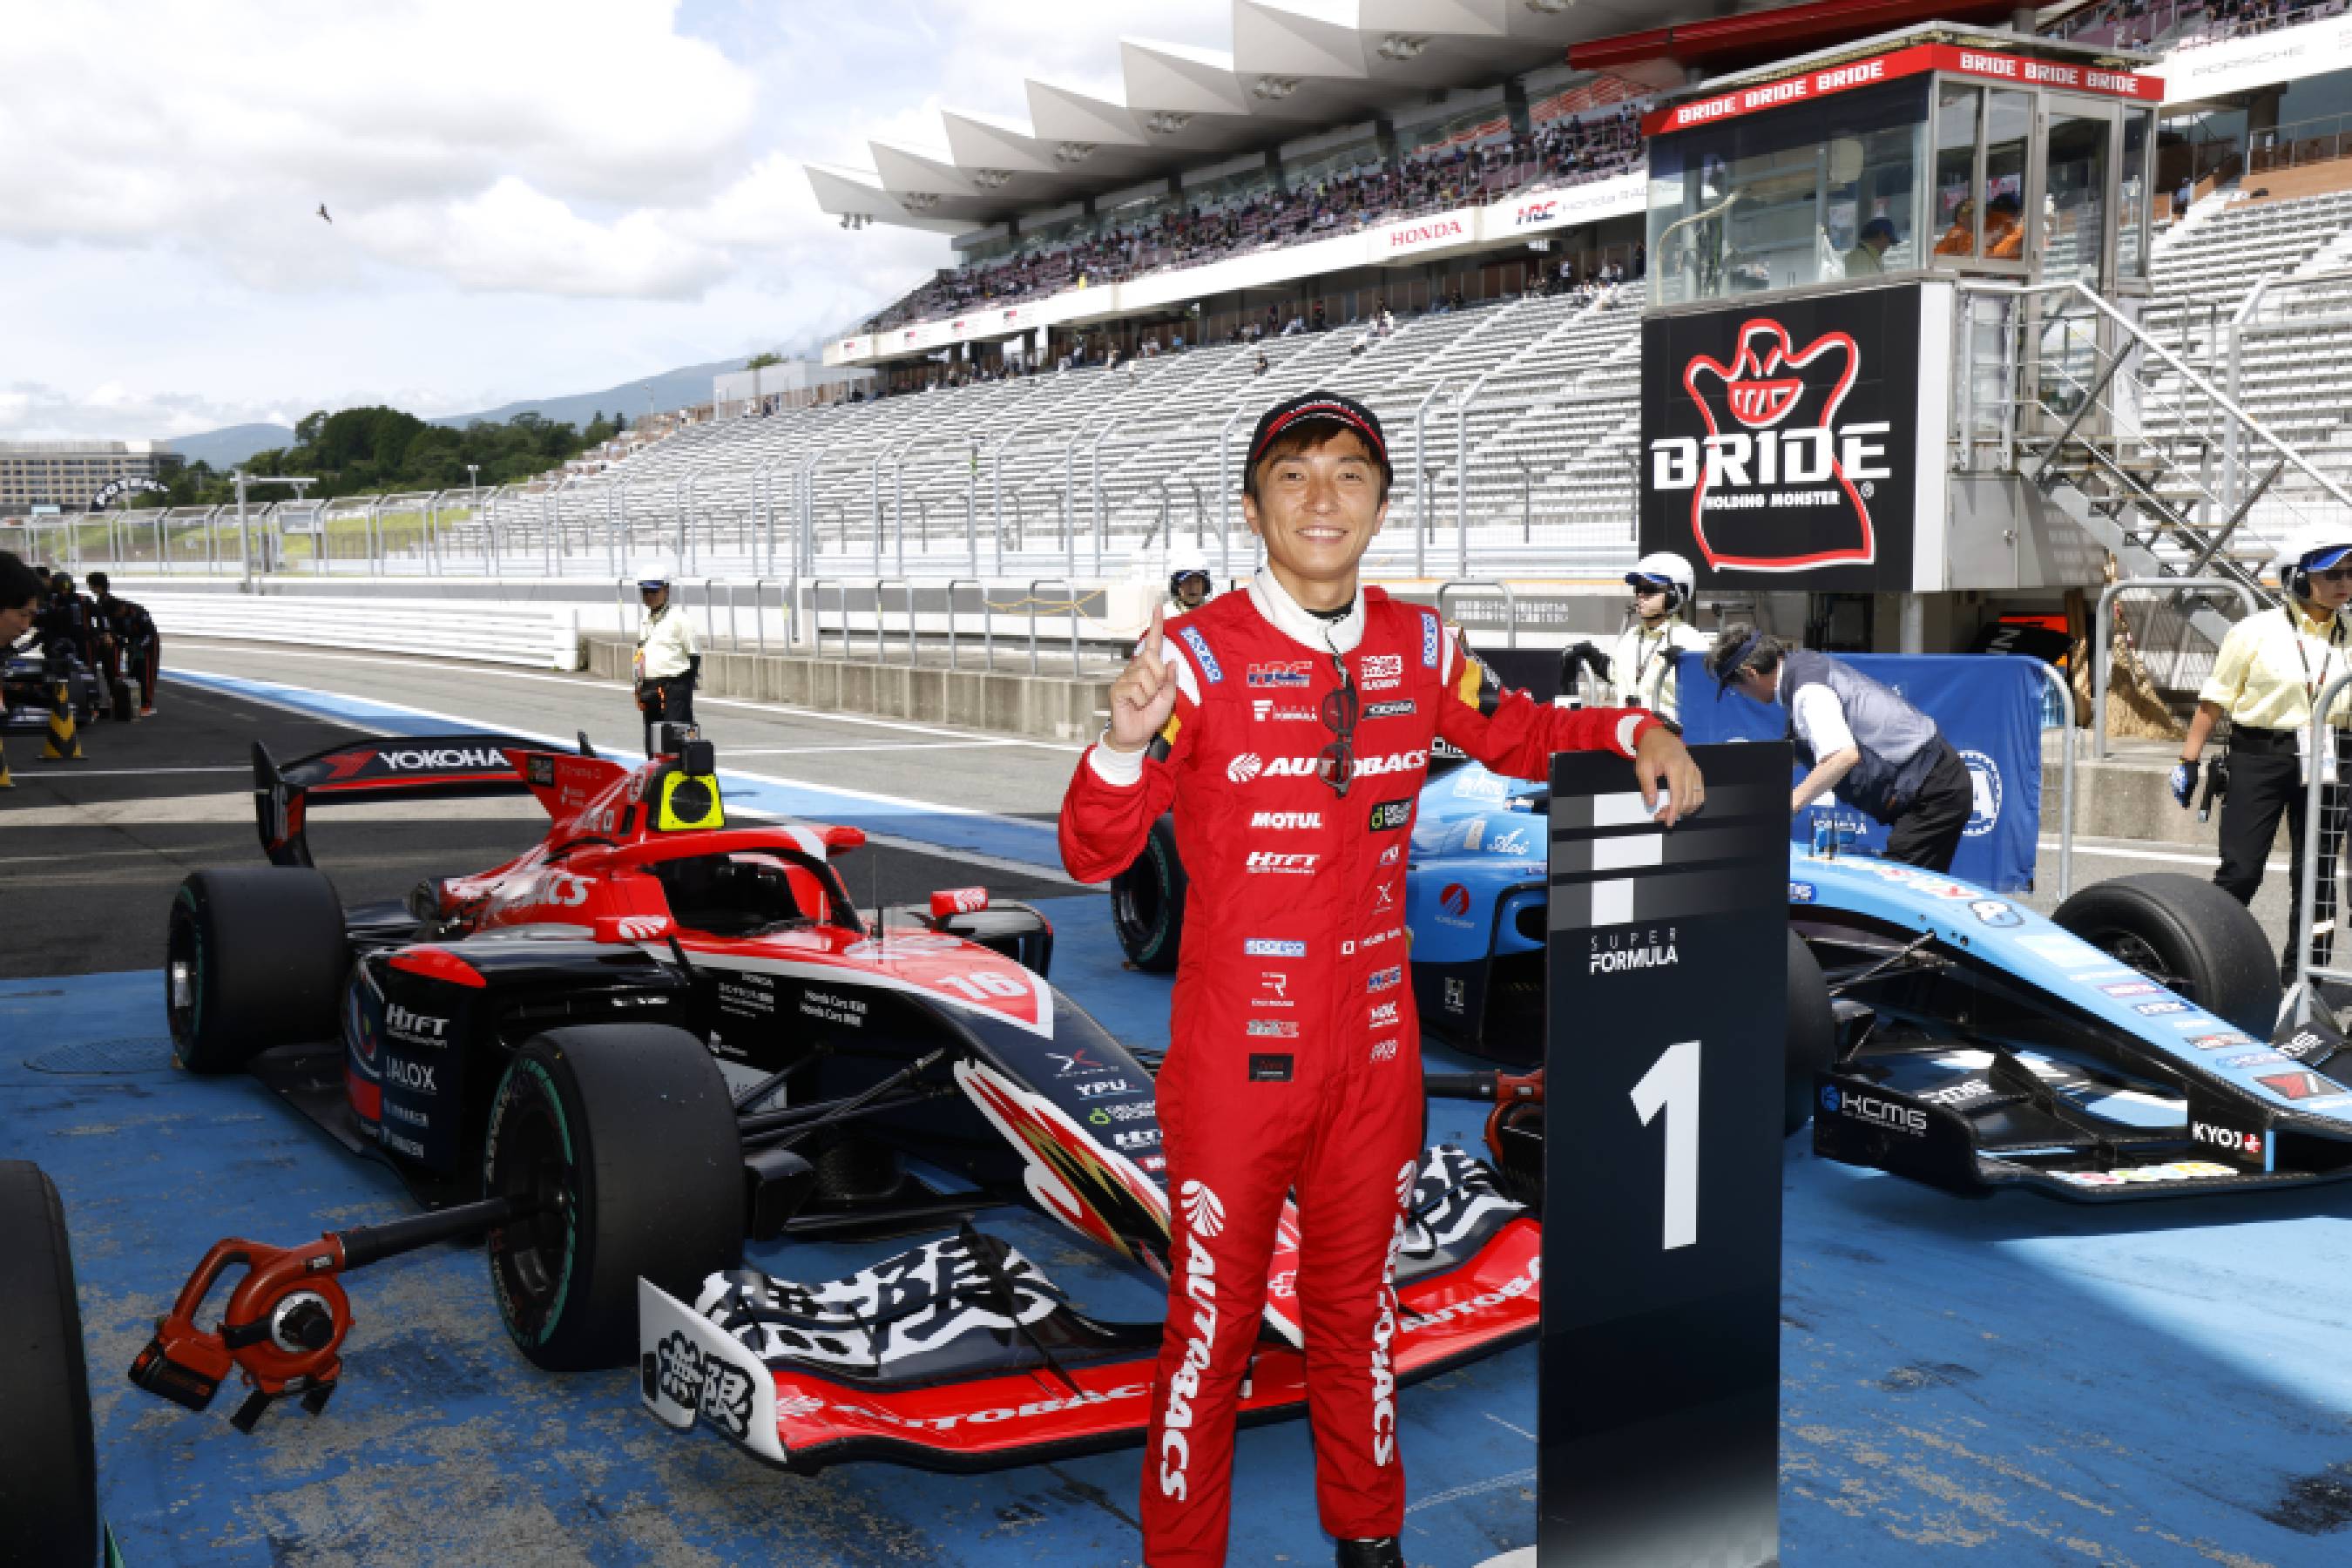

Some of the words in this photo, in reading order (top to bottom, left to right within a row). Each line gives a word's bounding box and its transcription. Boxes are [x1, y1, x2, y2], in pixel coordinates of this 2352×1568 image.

[1959, 53, 2016, 77] BRIDE
[2024, 62, 2078, 84] BRIDE
[2086, 71, 2139, 94] BRIDE
[1677, 97, 1736, 125] BRIDE
[1745, 79, 1807, 108] BRIDE
[1816, 60, 1885, 91] BRIDE
[1390, 220, 1462, 246] HONDA
[1650, 422, 1891, 490] BRIDE
[1703, 494, 1765, 510] HOLDING
[1769, 491, 1840, 507] MONSTER
[379, 747, 511, 769] YOKOHA
[1251, 812, 1322, 829] MOTUL
[1591, 927, 1677, 951] SUPER
[1590, 944, 1678, 975] FORMULA
[936, 970, 1028, 1000] 16
[386, 1004, 450, 1036] HTFT
[1074, 1078, 1127, 1096] YPU
[1842, 1091, 1927, 1130] KCMG
[1630, 1040, 1701, 1250] 1
[1159, 1233, 1216, 1502] AUTOBACS
[835, 1382, 1156, 1431] AUTOBAC
